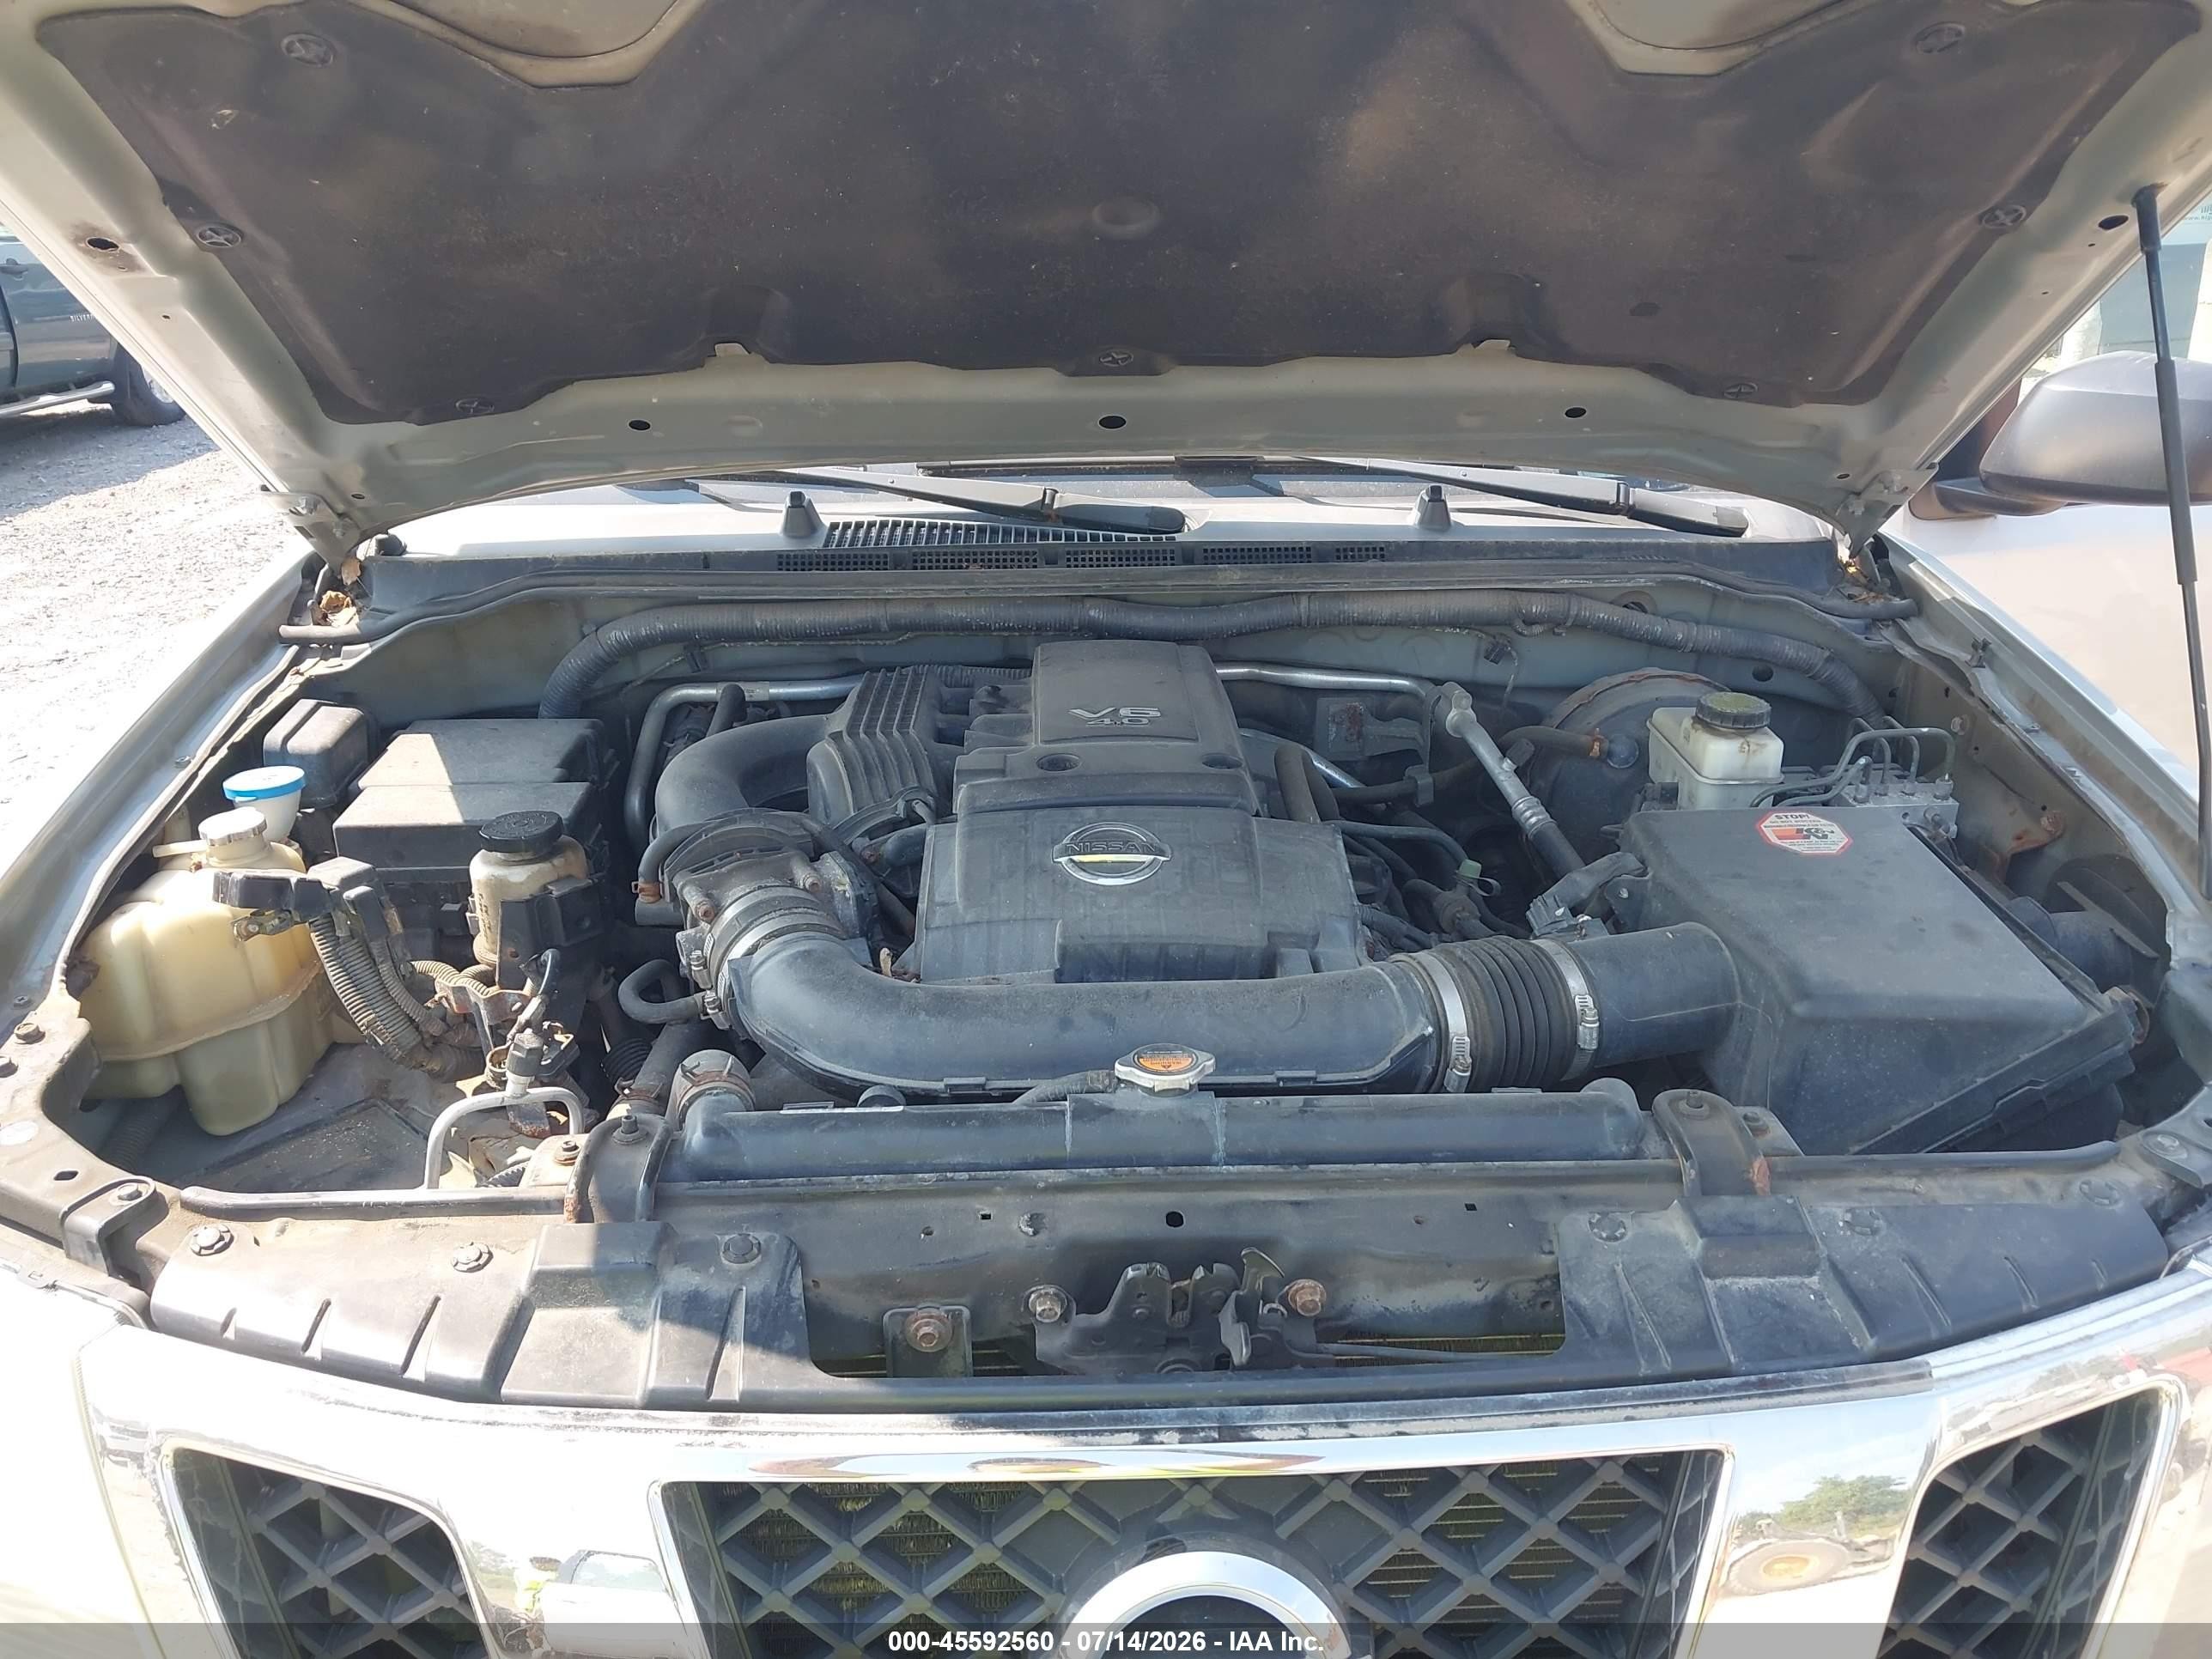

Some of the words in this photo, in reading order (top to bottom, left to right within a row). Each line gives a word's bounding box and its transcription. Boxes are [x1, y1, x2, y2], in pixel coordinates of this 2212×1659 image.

[1068, 707, 1162, 720] V6
[1085, 718, 1150, 726] 4.0
[1066, 842, 1158, 854] NISSAN
